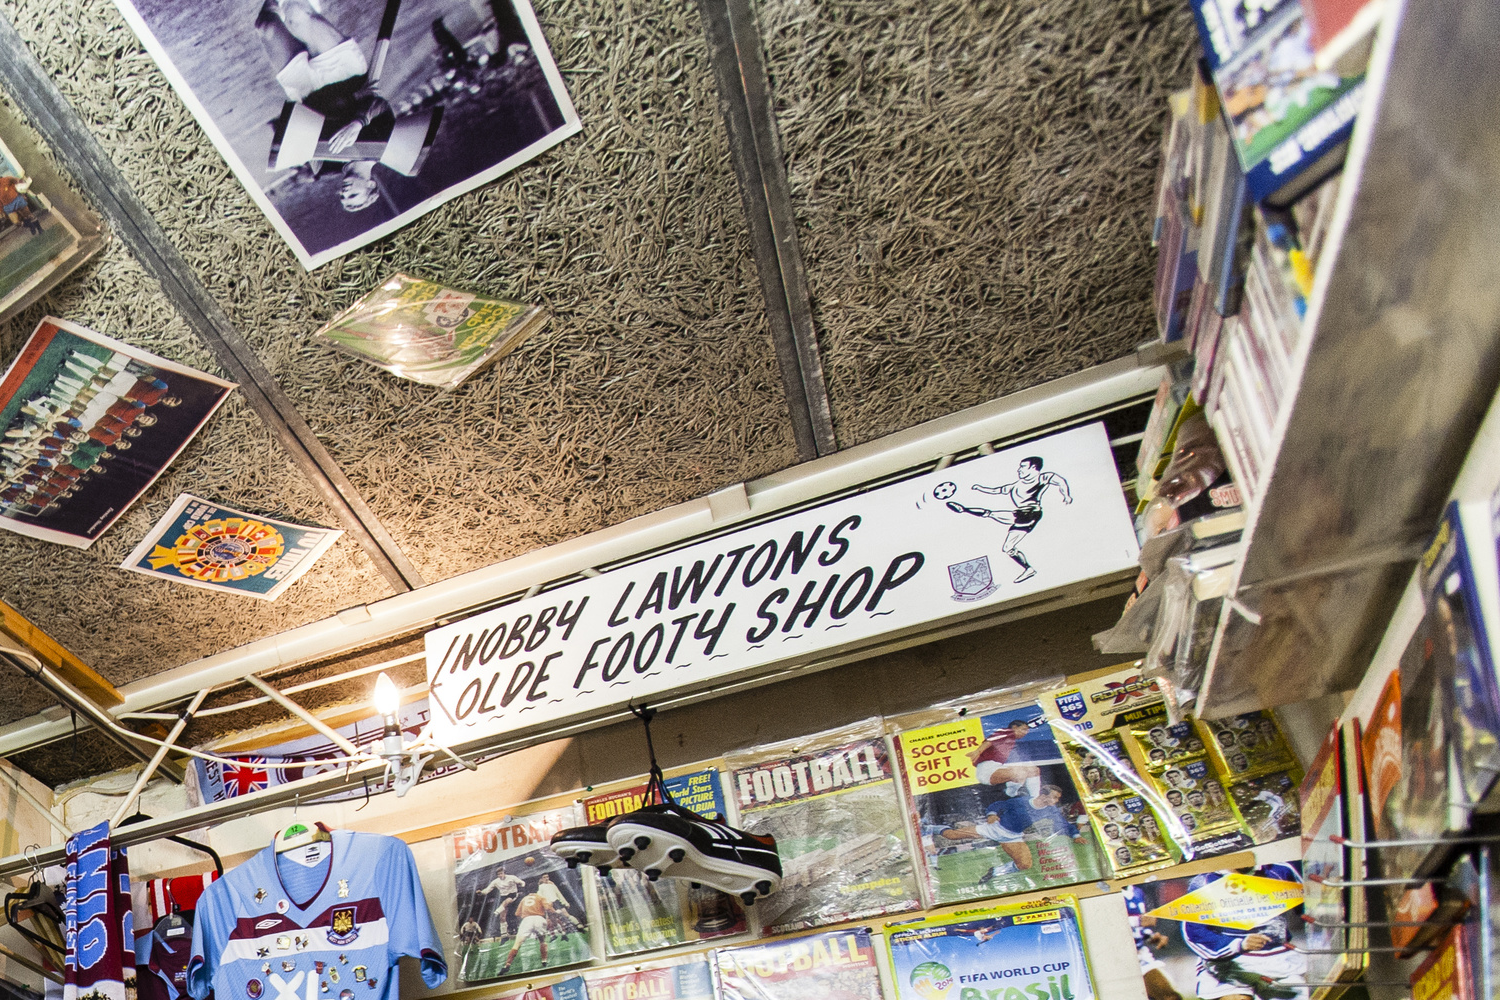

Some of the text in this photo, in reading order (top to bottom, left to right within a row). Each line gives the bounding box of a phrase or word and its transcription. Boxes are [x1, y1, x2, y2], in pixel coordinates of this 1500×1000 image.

[455, 514, 862, 673] NOBBY LAWTONS
[455, 550, 925, 719] OLDE FOOTY SHOP
[911, 736, 979, 759] SOCCER
[913, 756, 952, 773] GIFT
[688, 774, 711, 786] FREE!
[737, 750, 886, 804] FOOTBALL
[917, 768, 970, 788] BOOK
[679, 792, 714, 804] PICTURE
[1013, 910, 1060, 924] PANINI
[959, 961, 1071, 985] FIFA WORLD CUP
